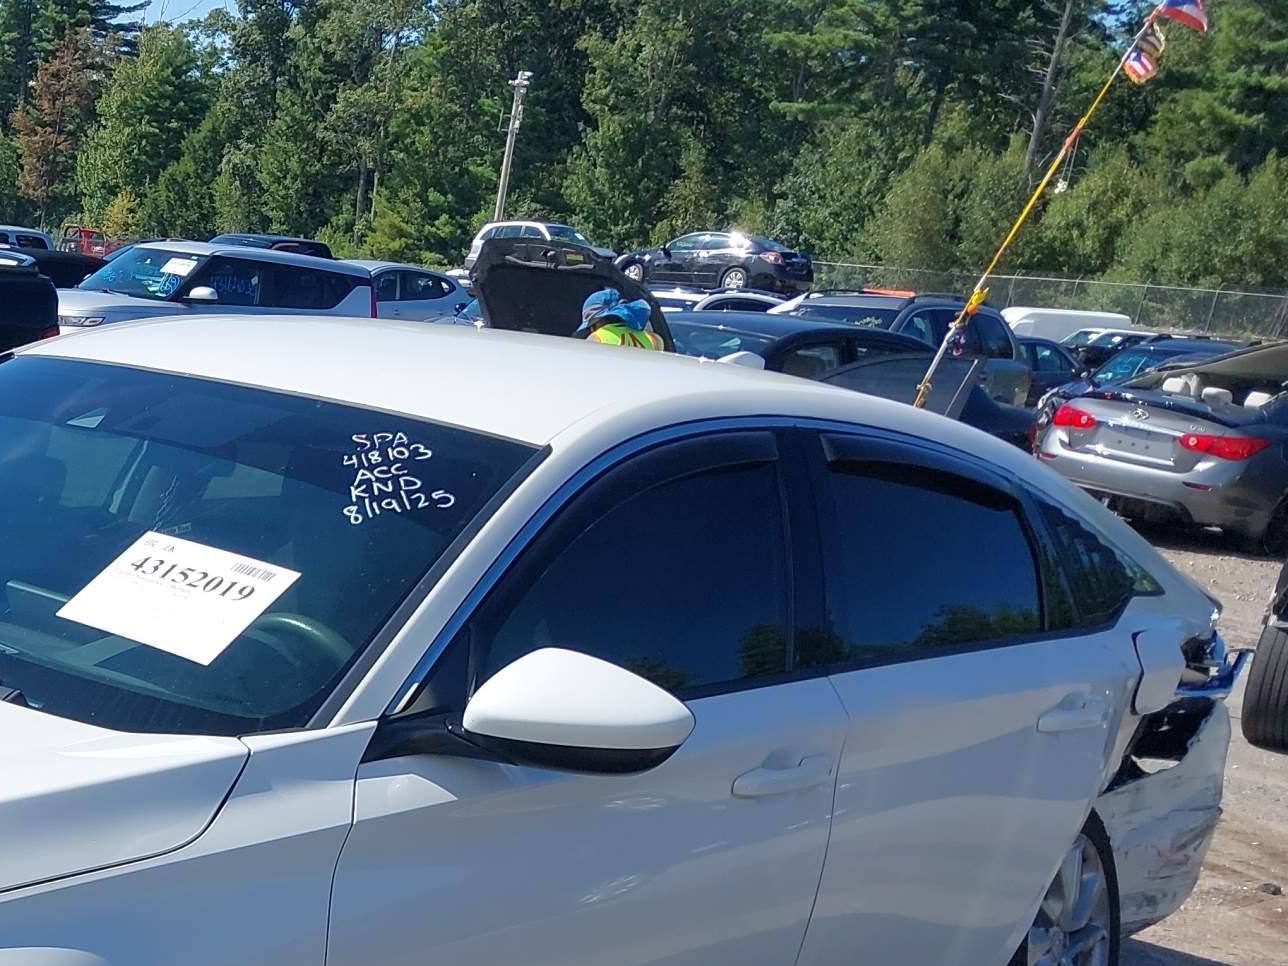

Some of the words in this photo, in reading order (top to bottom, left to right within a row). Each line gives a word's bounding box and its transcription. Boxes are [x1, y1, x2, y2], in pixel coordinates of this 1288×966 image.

[351, 432, 408, 451] SPA
[343, 443, 433, 468] 418103
[353, 463, 409, 487] ACC
[350, 476, 422, 502] KND
[343, 490, 456, 524] 8/19/25
[130, 555, 256, 601] 43152019
